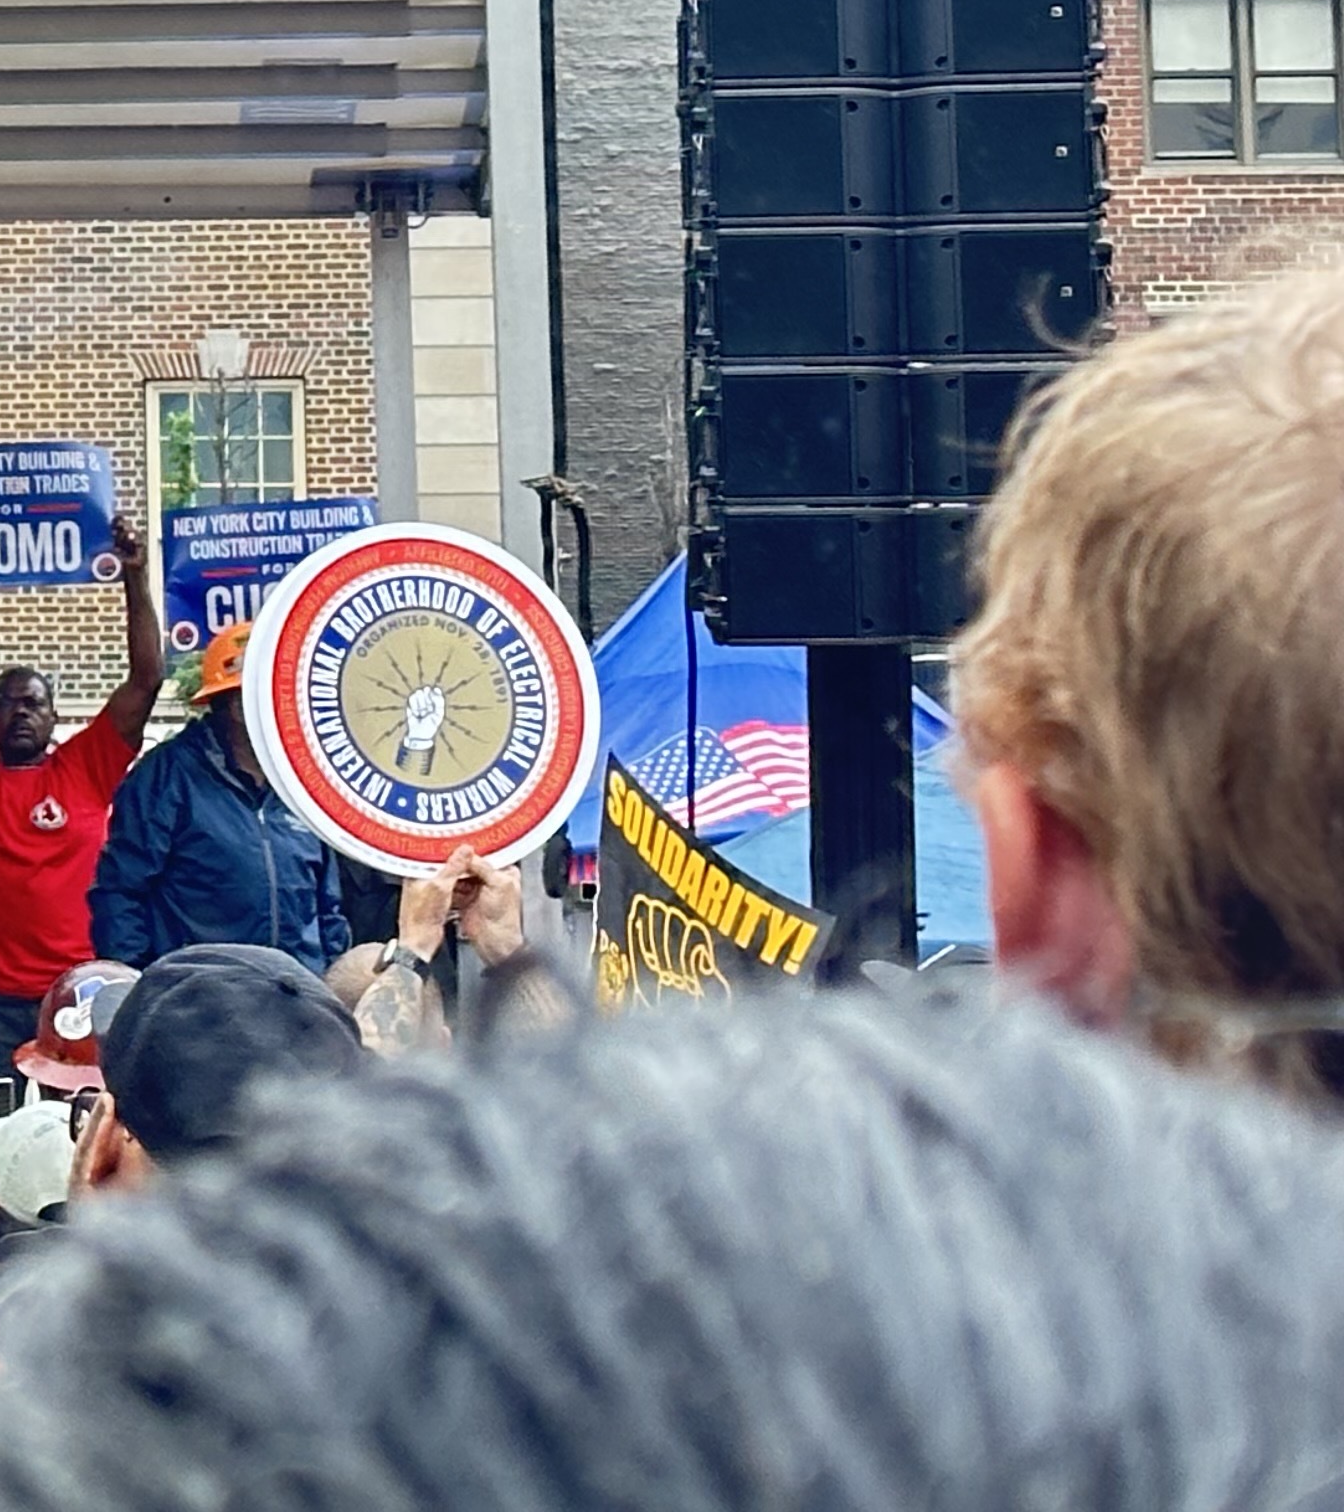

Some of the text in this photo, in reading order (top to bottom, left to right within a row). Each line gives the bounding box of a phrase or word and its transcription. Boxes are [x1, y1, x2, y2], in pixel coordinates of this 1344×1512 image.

[18, 451, 86, 471] BUILDING
[88, 454, 101, 472] &
[34, 474, 90, 494] TRADES
[173, 516, 210, 536] NEW
[211, 513, 251, 534] YORK
[252, 511, 287, 532] CITY
[290, 506, 358, 530] BUILDING
[190, 536, 304, 560] CONSTRUCTION
[330, 579, 475, 642] BROTHERHOOD
[476, 607, 510, 639] OF
[356, 615, 430, 658] ORGANIZED
[310, 642, 393, 808] INTERNATIONAL
[499, 639, 544, 770] ELECTRICAL
[416, 767, 516, 822] WORKERS
[607, 770, 818, 976] SOLIDARITY!
